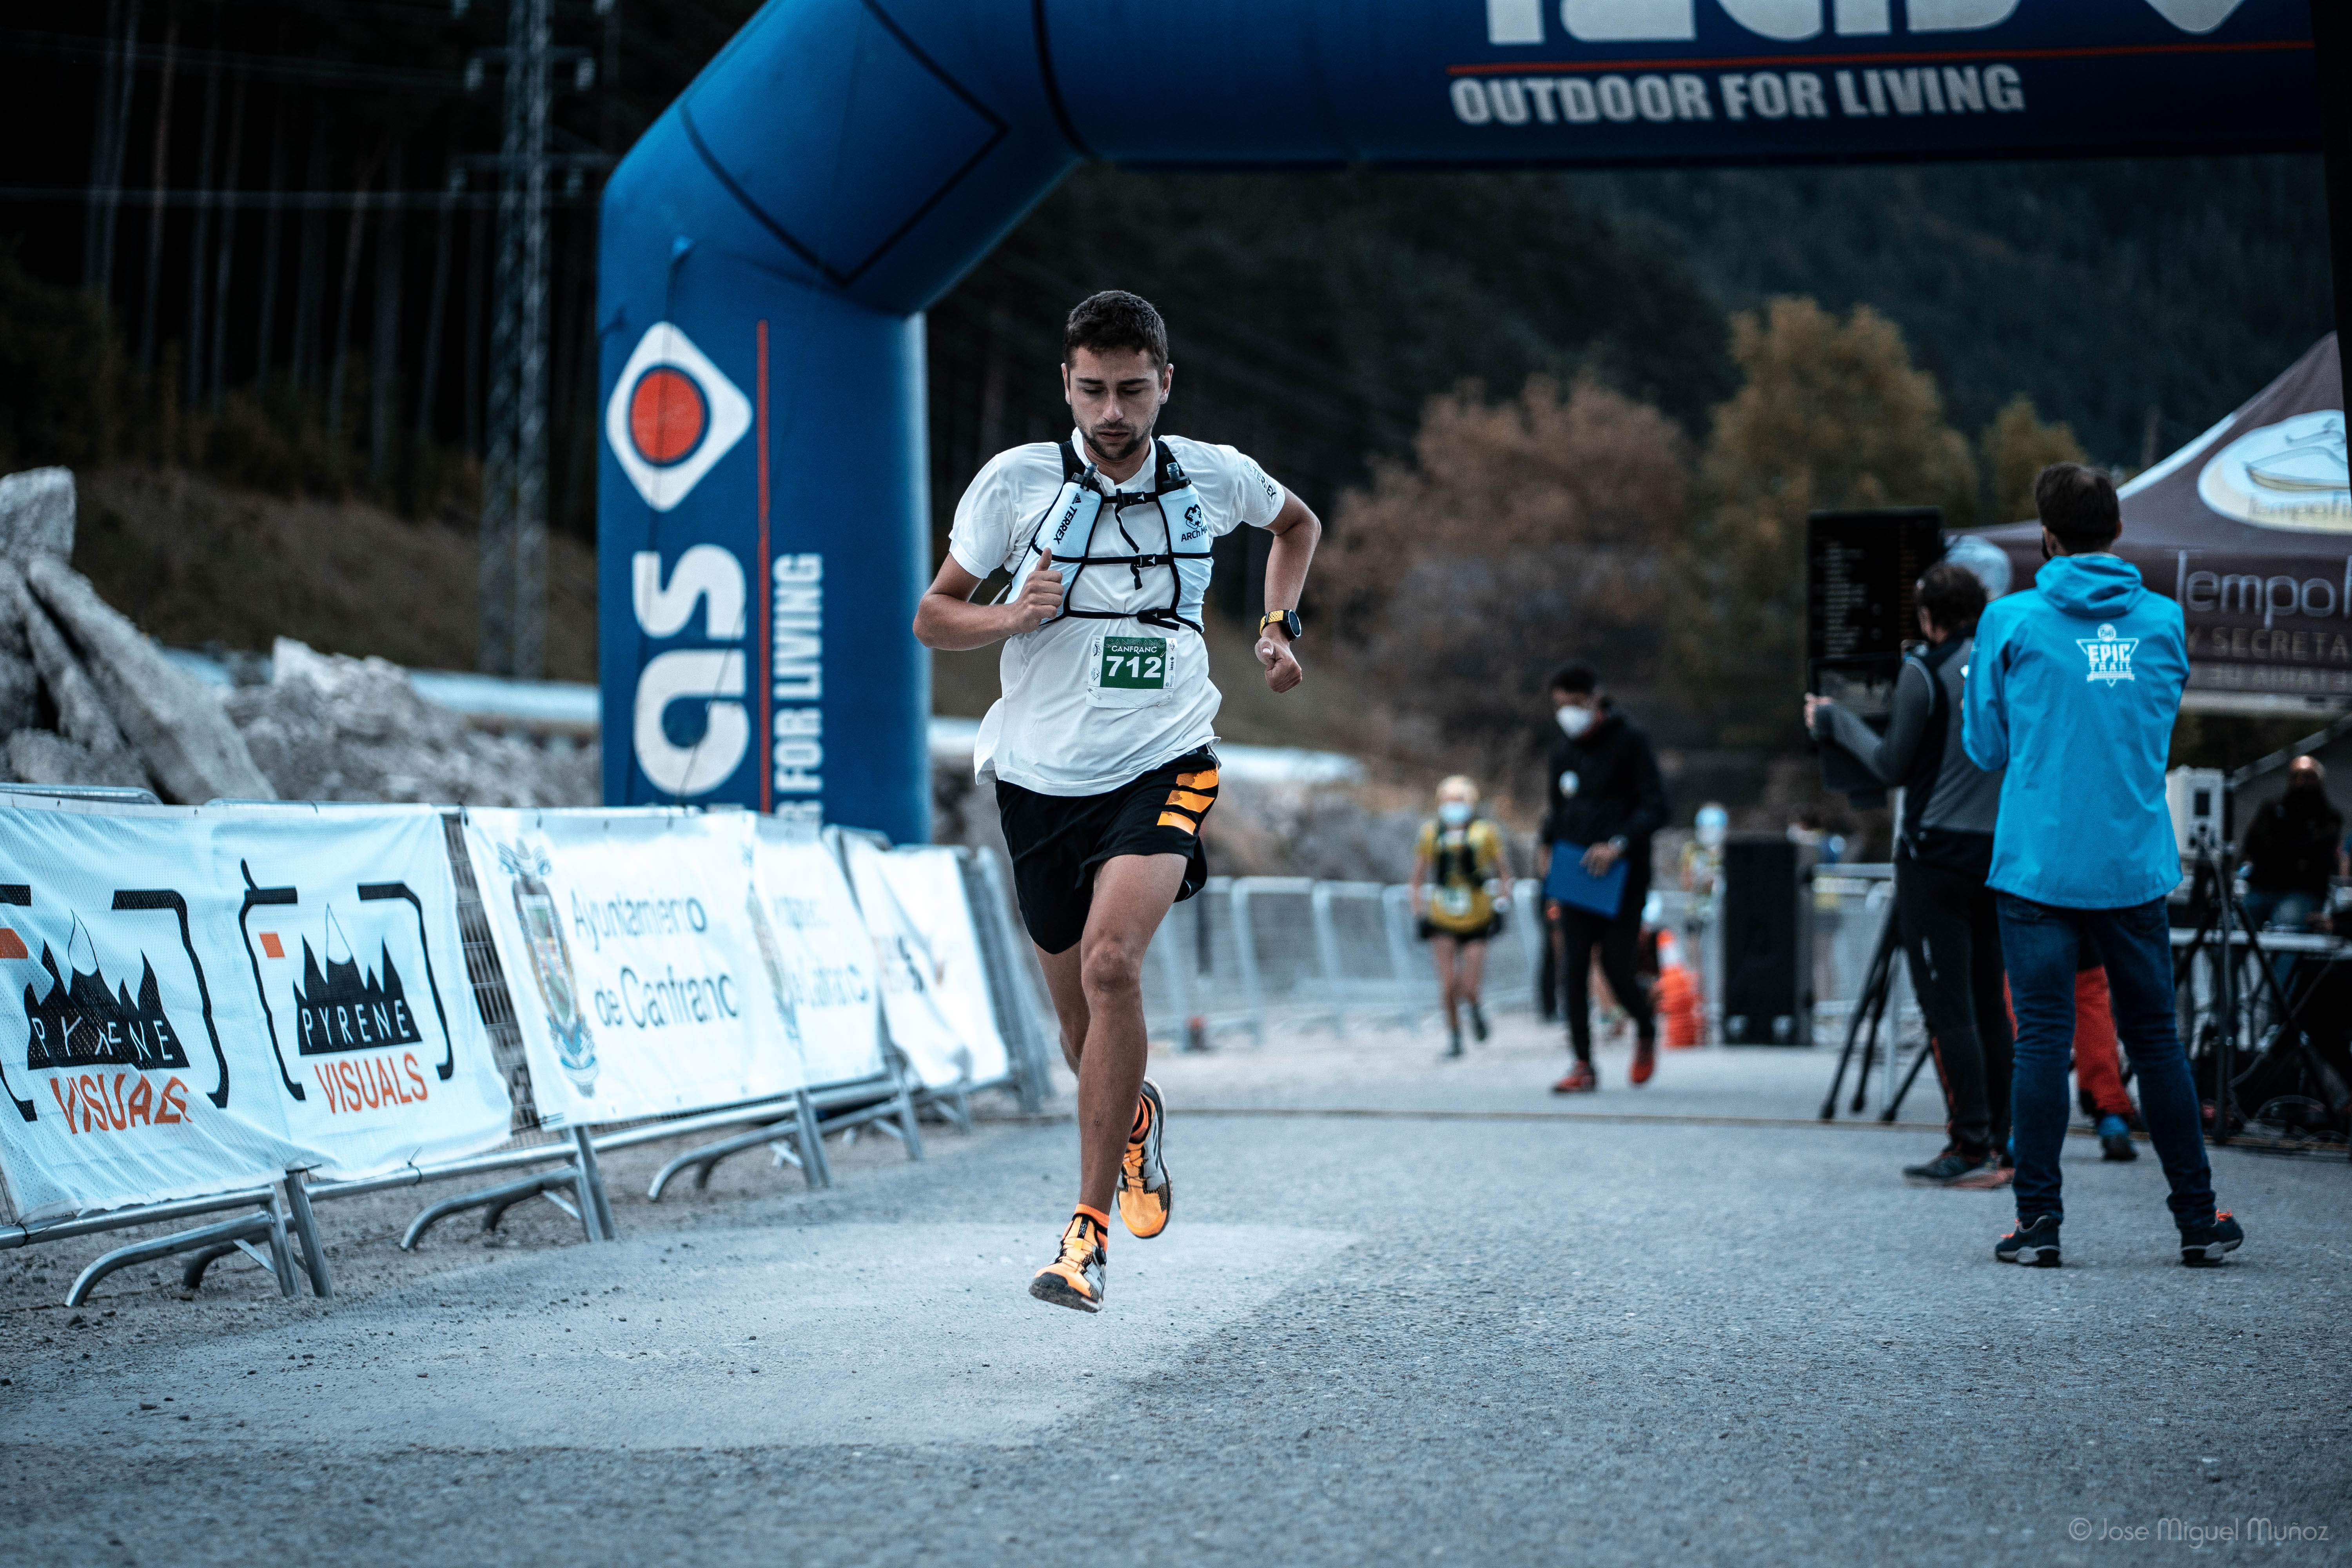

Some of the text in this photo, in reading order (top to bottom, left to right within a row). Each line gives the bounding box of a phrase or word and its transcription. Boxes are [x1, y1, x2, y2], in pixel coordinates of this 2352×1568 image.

[1449, 64, 2026, 125] OUTDOOR FOR LIVING
[1053, 506, 1078, 545] TERREX
[773, 552, 823, 700] LIVING
[1112, 645, 1157, 654] CANFRANC
[2087, 644, 2131, 662] EPIC
[632, 543, 750, 812] as
[1106, 656, 1162, 678] 712
[773, 708, 823, 793] FOR
[570, 887, 709, 952] Ayuntamiento
[301, 999, 410, 1047] PYRENE
[594, 980, 623, 1027] de
[620, 964, 739, 1029] Canfranc
[314, 1052, 428, 1114] VISUALS
